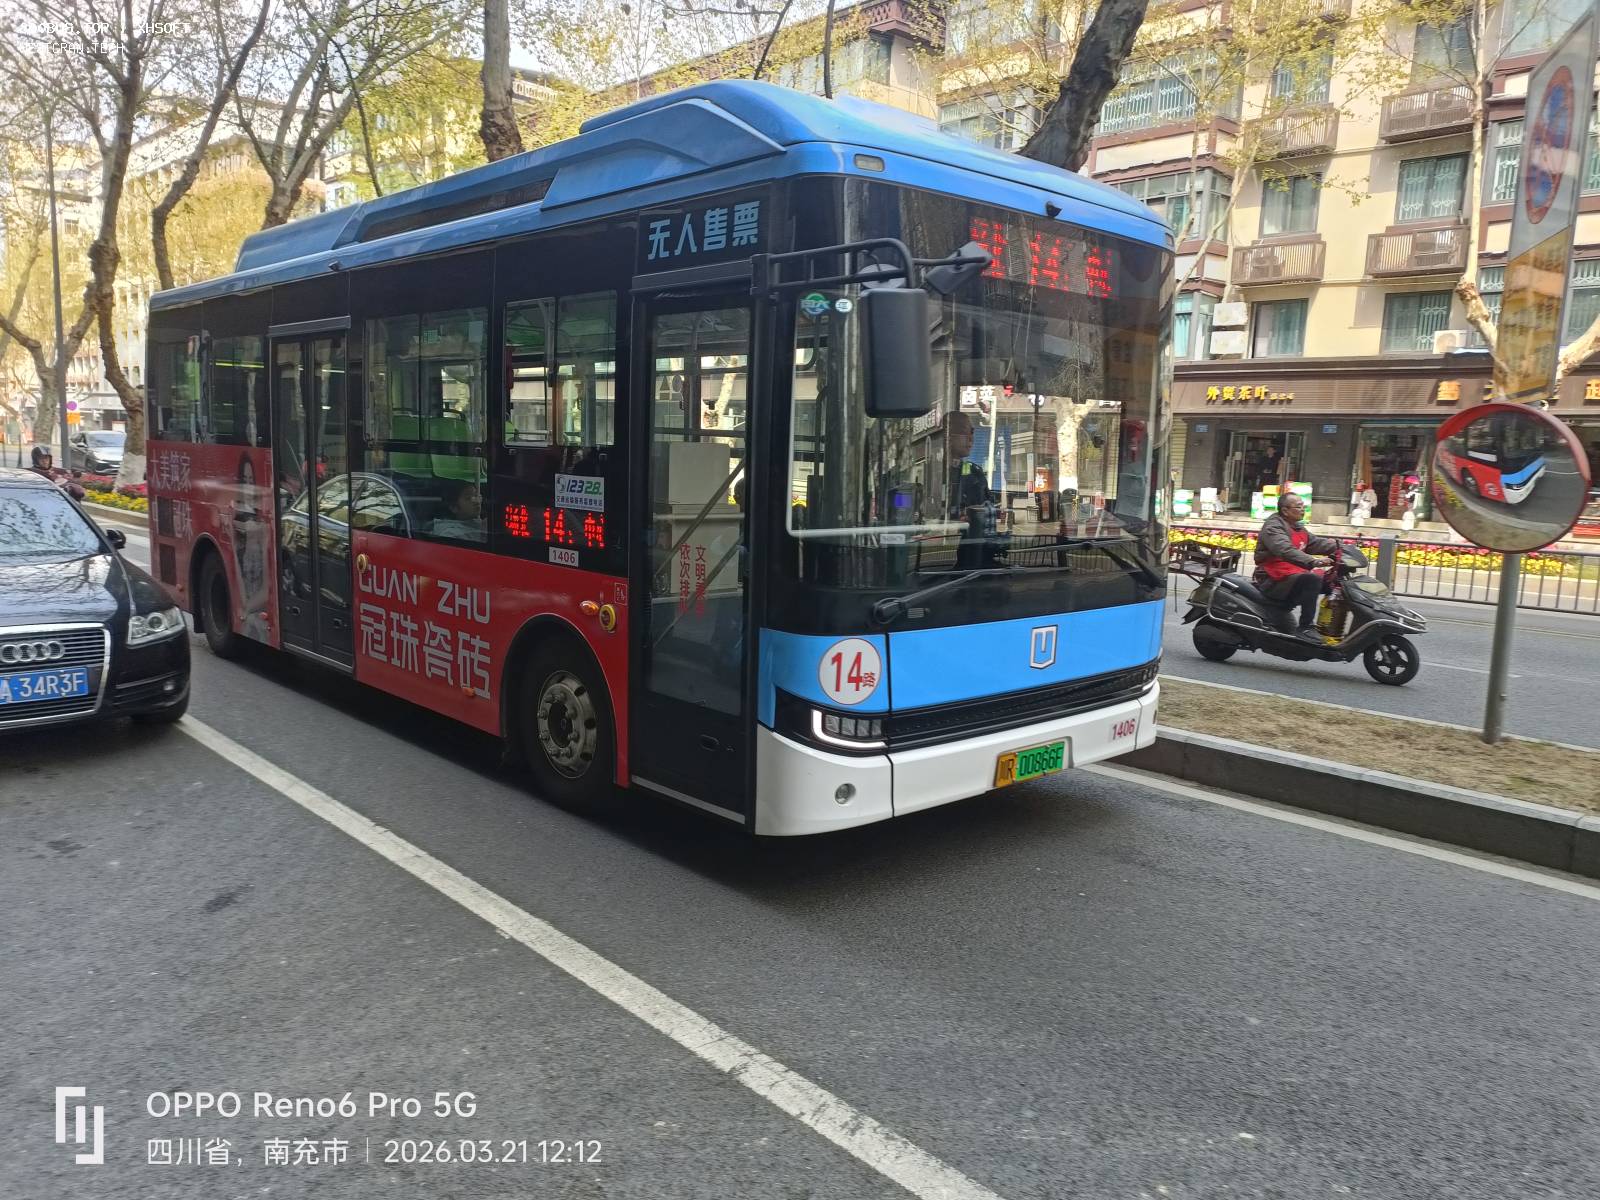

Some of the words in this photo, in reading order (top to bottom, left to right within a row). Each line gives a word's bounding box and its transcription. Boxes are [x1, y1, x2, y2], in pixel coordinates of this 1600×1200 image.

[648, 200, 760, 260] 无人售票
[151, 495, 193, 543] 中冠珠
[552, 550, 576, 563] 1406
[359, 564, 417, 605] GUAN
[437, 580, 490, 624] ZHU
[360, 602, 491, 700] 冠珠瓷砖
[1112, 718, 1136, 740] 1406
